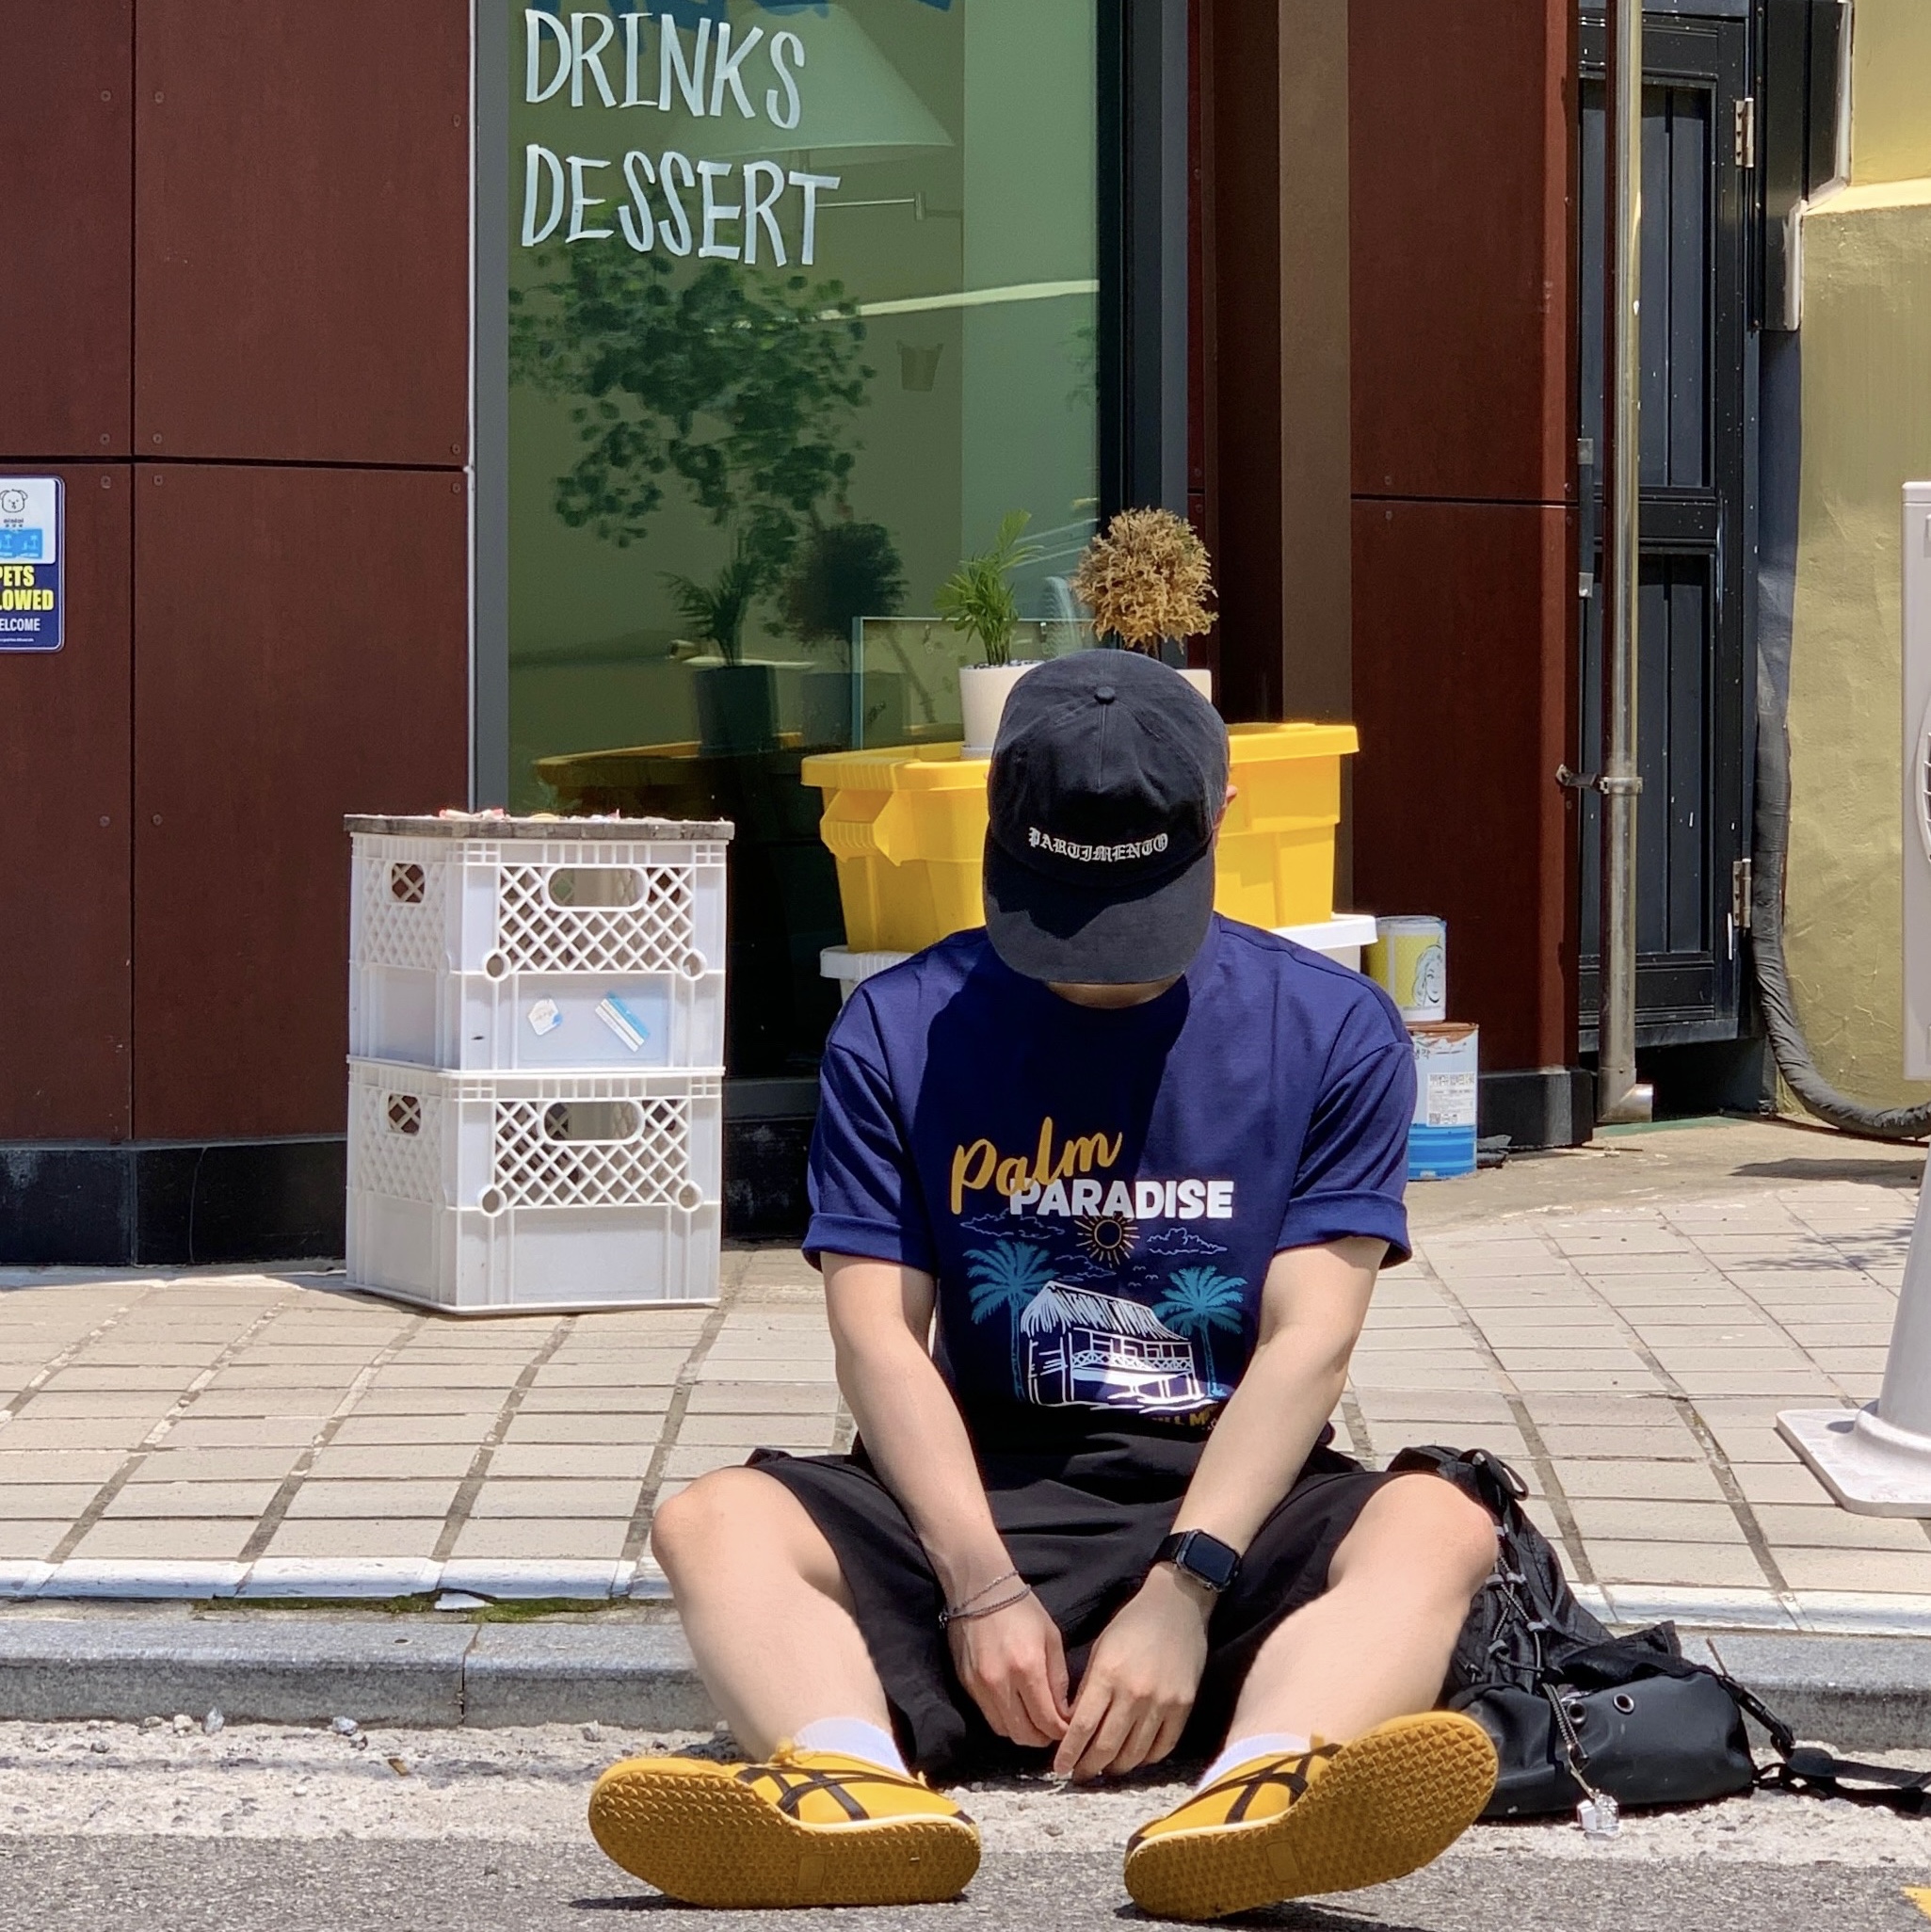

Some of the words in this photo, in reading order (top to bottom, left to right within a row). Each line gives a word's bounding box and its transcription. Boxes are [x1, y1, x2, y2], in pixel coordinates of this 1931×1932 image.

[524, 8, 805, 129] DRINKS
[522, 144, 841, 267] DESSERT
[0, 565, 35, 588] ETS
[0, 588, 55, 611] OWED
[1028, 827, 1169, 862] PARTIMENTO
[1009, 1178, 1234, 1220] PARADISE
